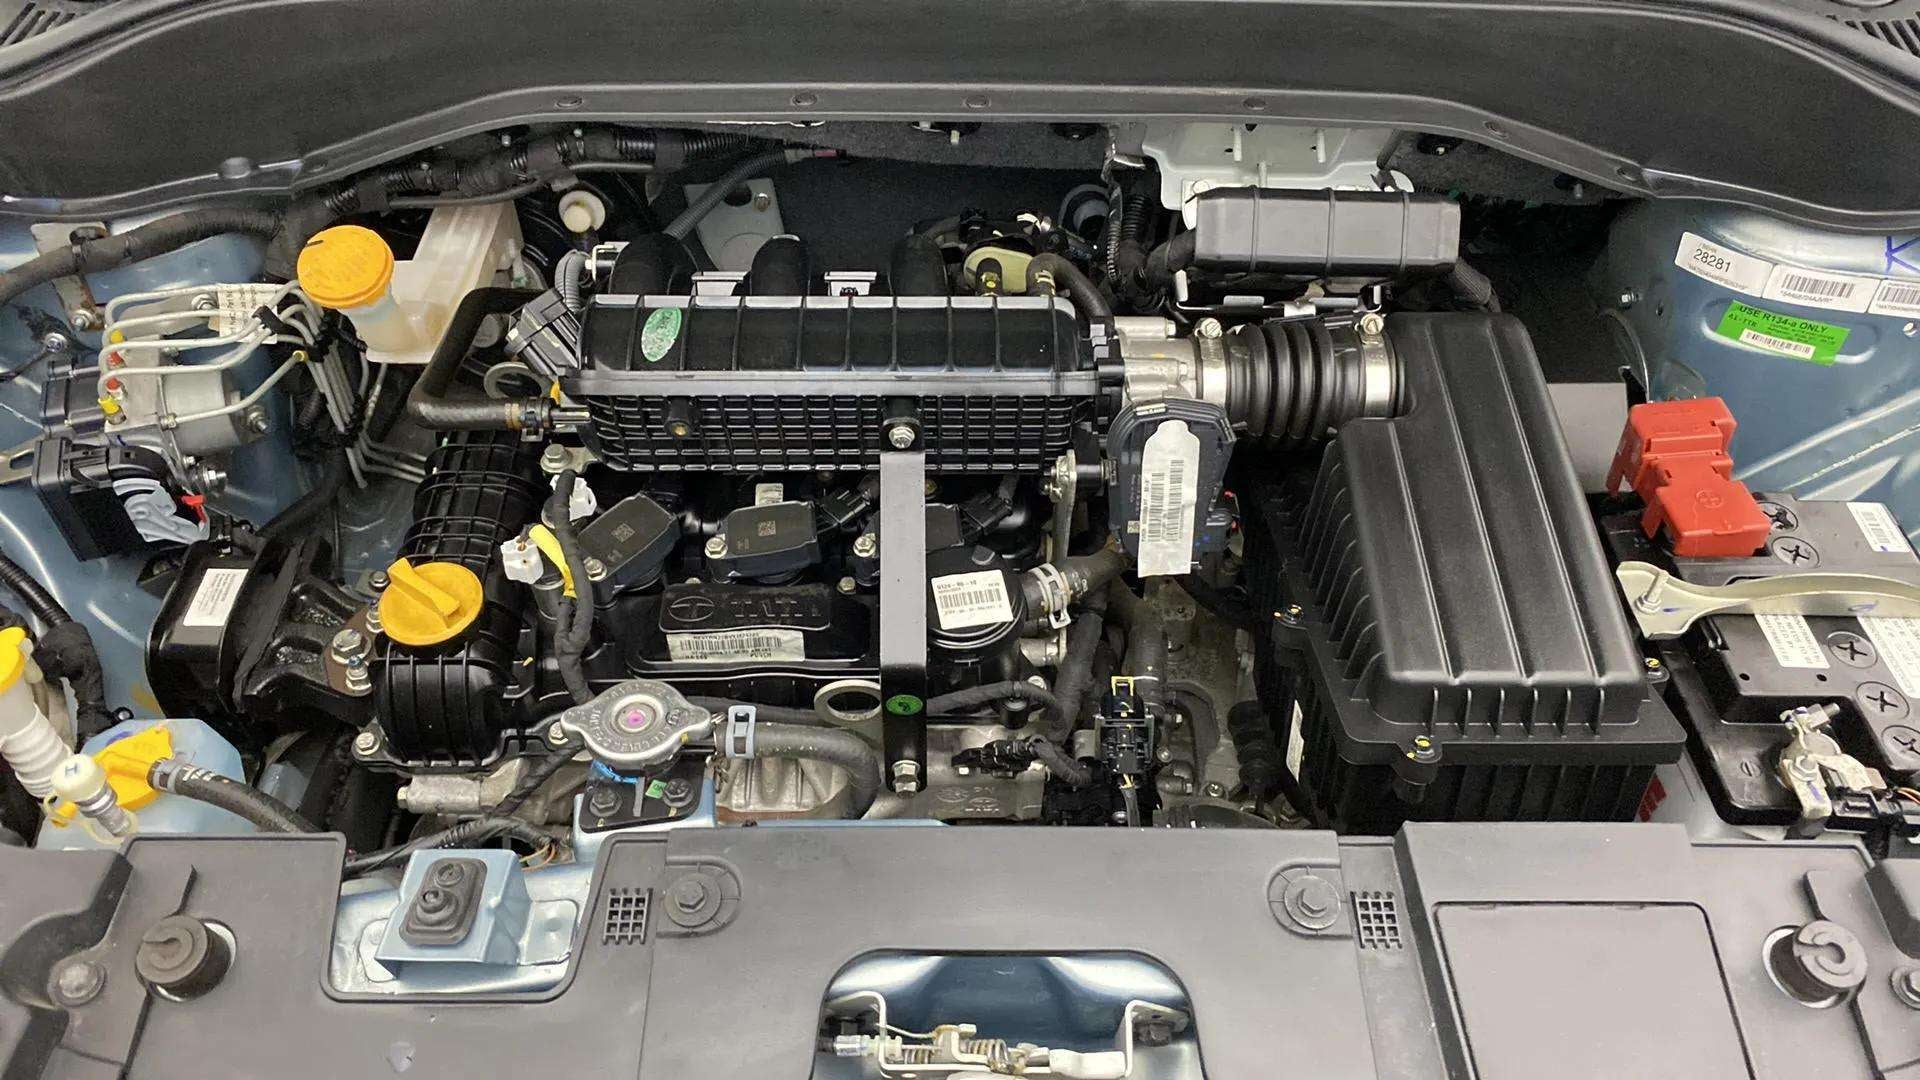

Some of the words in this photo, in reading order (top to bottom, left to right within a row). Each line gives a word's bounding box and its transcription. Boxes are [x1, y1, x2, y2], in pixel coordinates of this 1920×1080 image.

[1693, 248, 1731, 272] 28281
[1740, 305, 1760, 317] USE
[1799, 321, 1828, 333] ONLY
